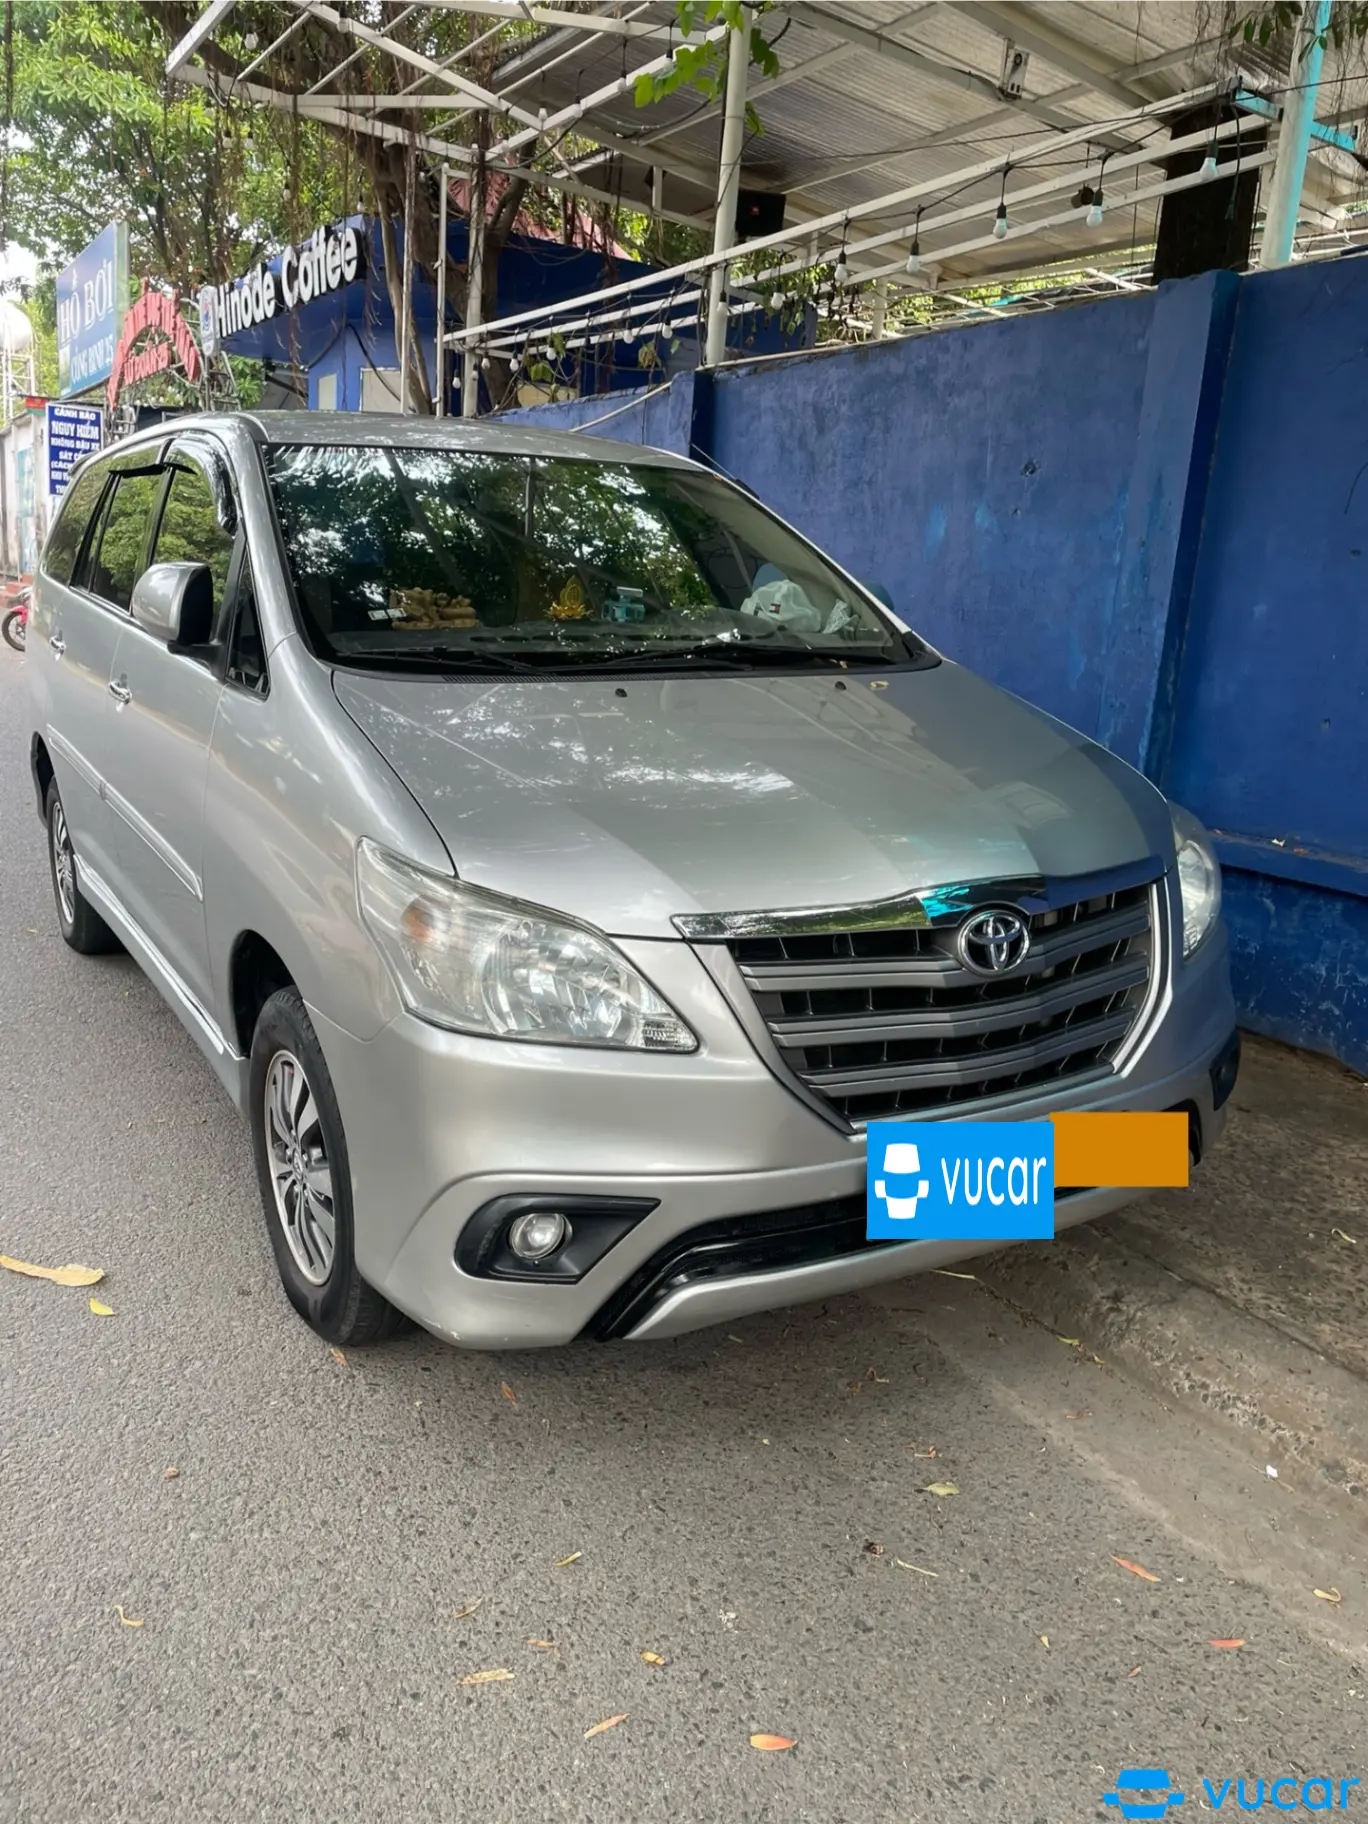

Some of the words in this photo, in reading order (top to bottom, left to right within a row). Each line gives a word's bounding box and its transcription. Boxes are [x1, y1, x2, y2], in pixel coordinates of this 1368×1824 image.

[216, 262, 275, 339] Hinode
[281, 224, 358, 307] Coffee
[51, 420, 75, 437] NGUY
